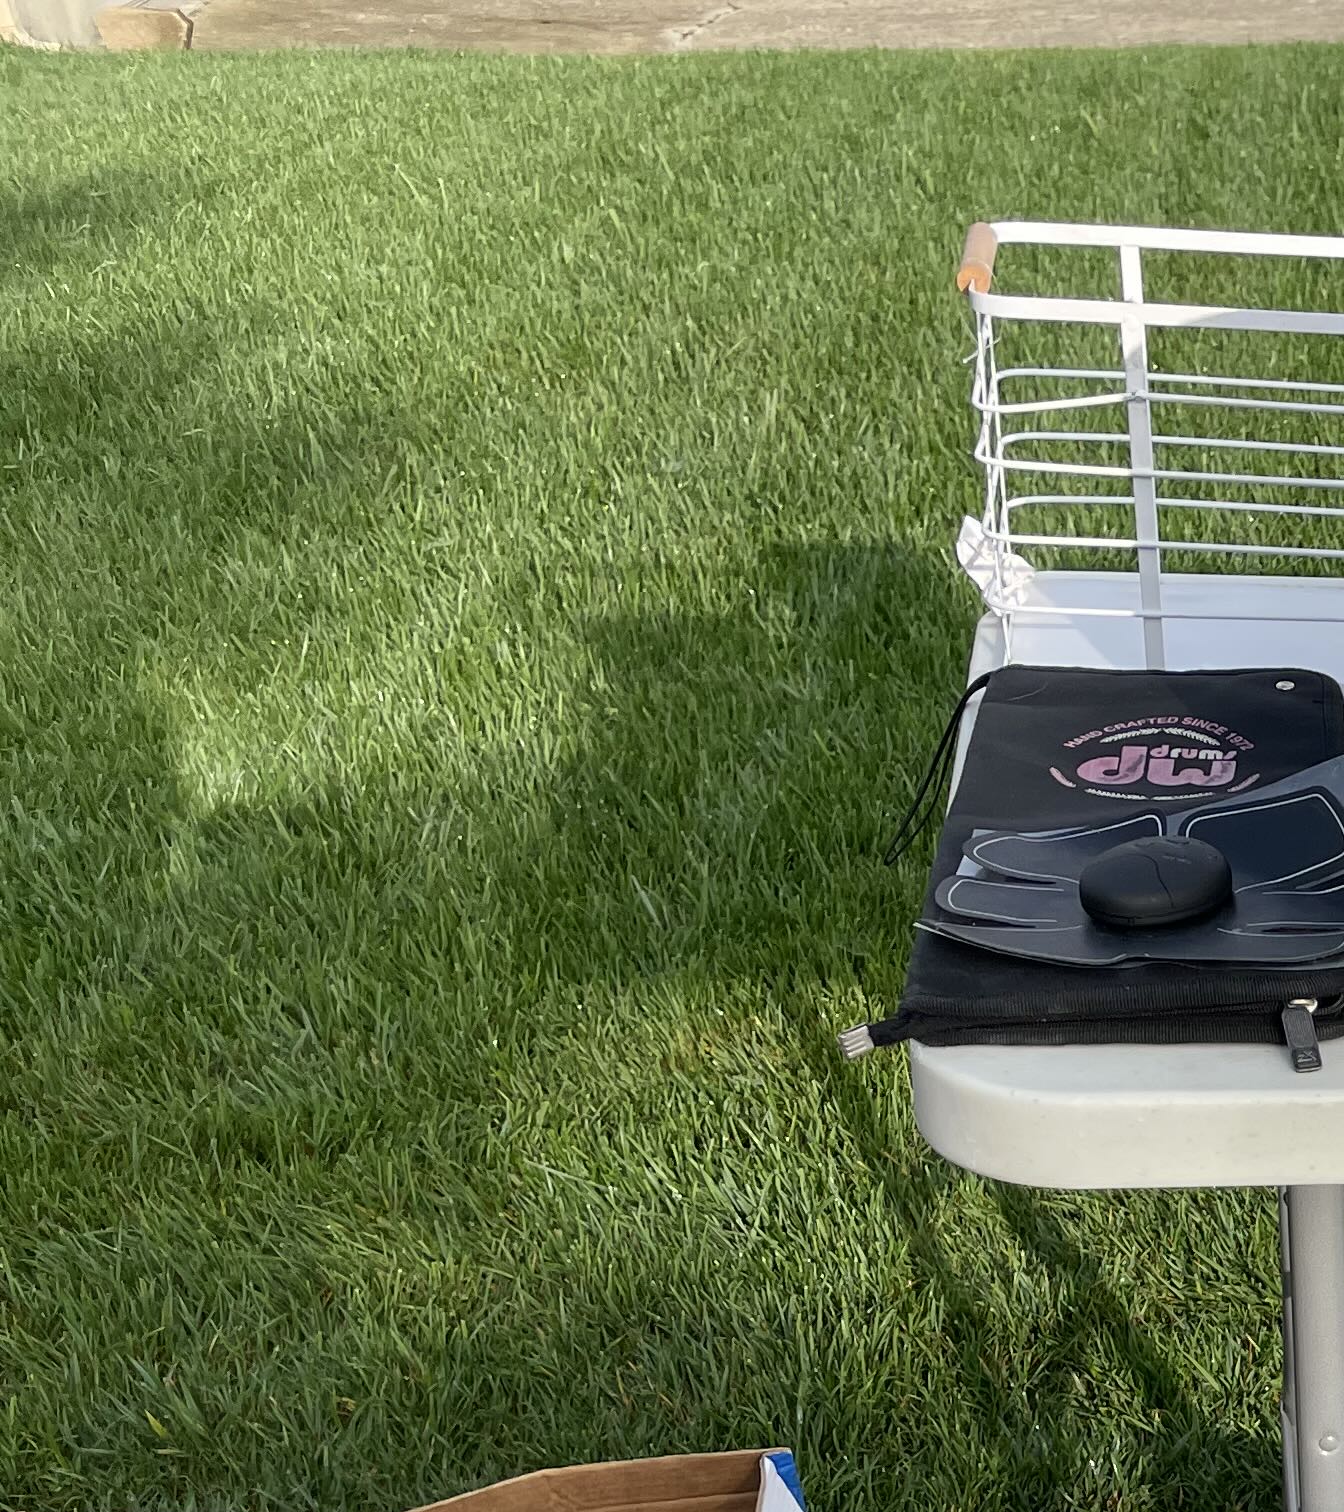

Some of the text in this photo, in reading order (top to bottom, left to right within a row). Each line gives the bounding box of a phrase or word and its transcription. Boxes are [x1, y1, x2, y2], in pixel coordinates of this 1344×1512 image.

[1063, 715, 1256, 751] HAND CRAFTED SINCE 1972
[1076, 746, 1238, 787] dw
[1150, 744, 1238, 760] drums
